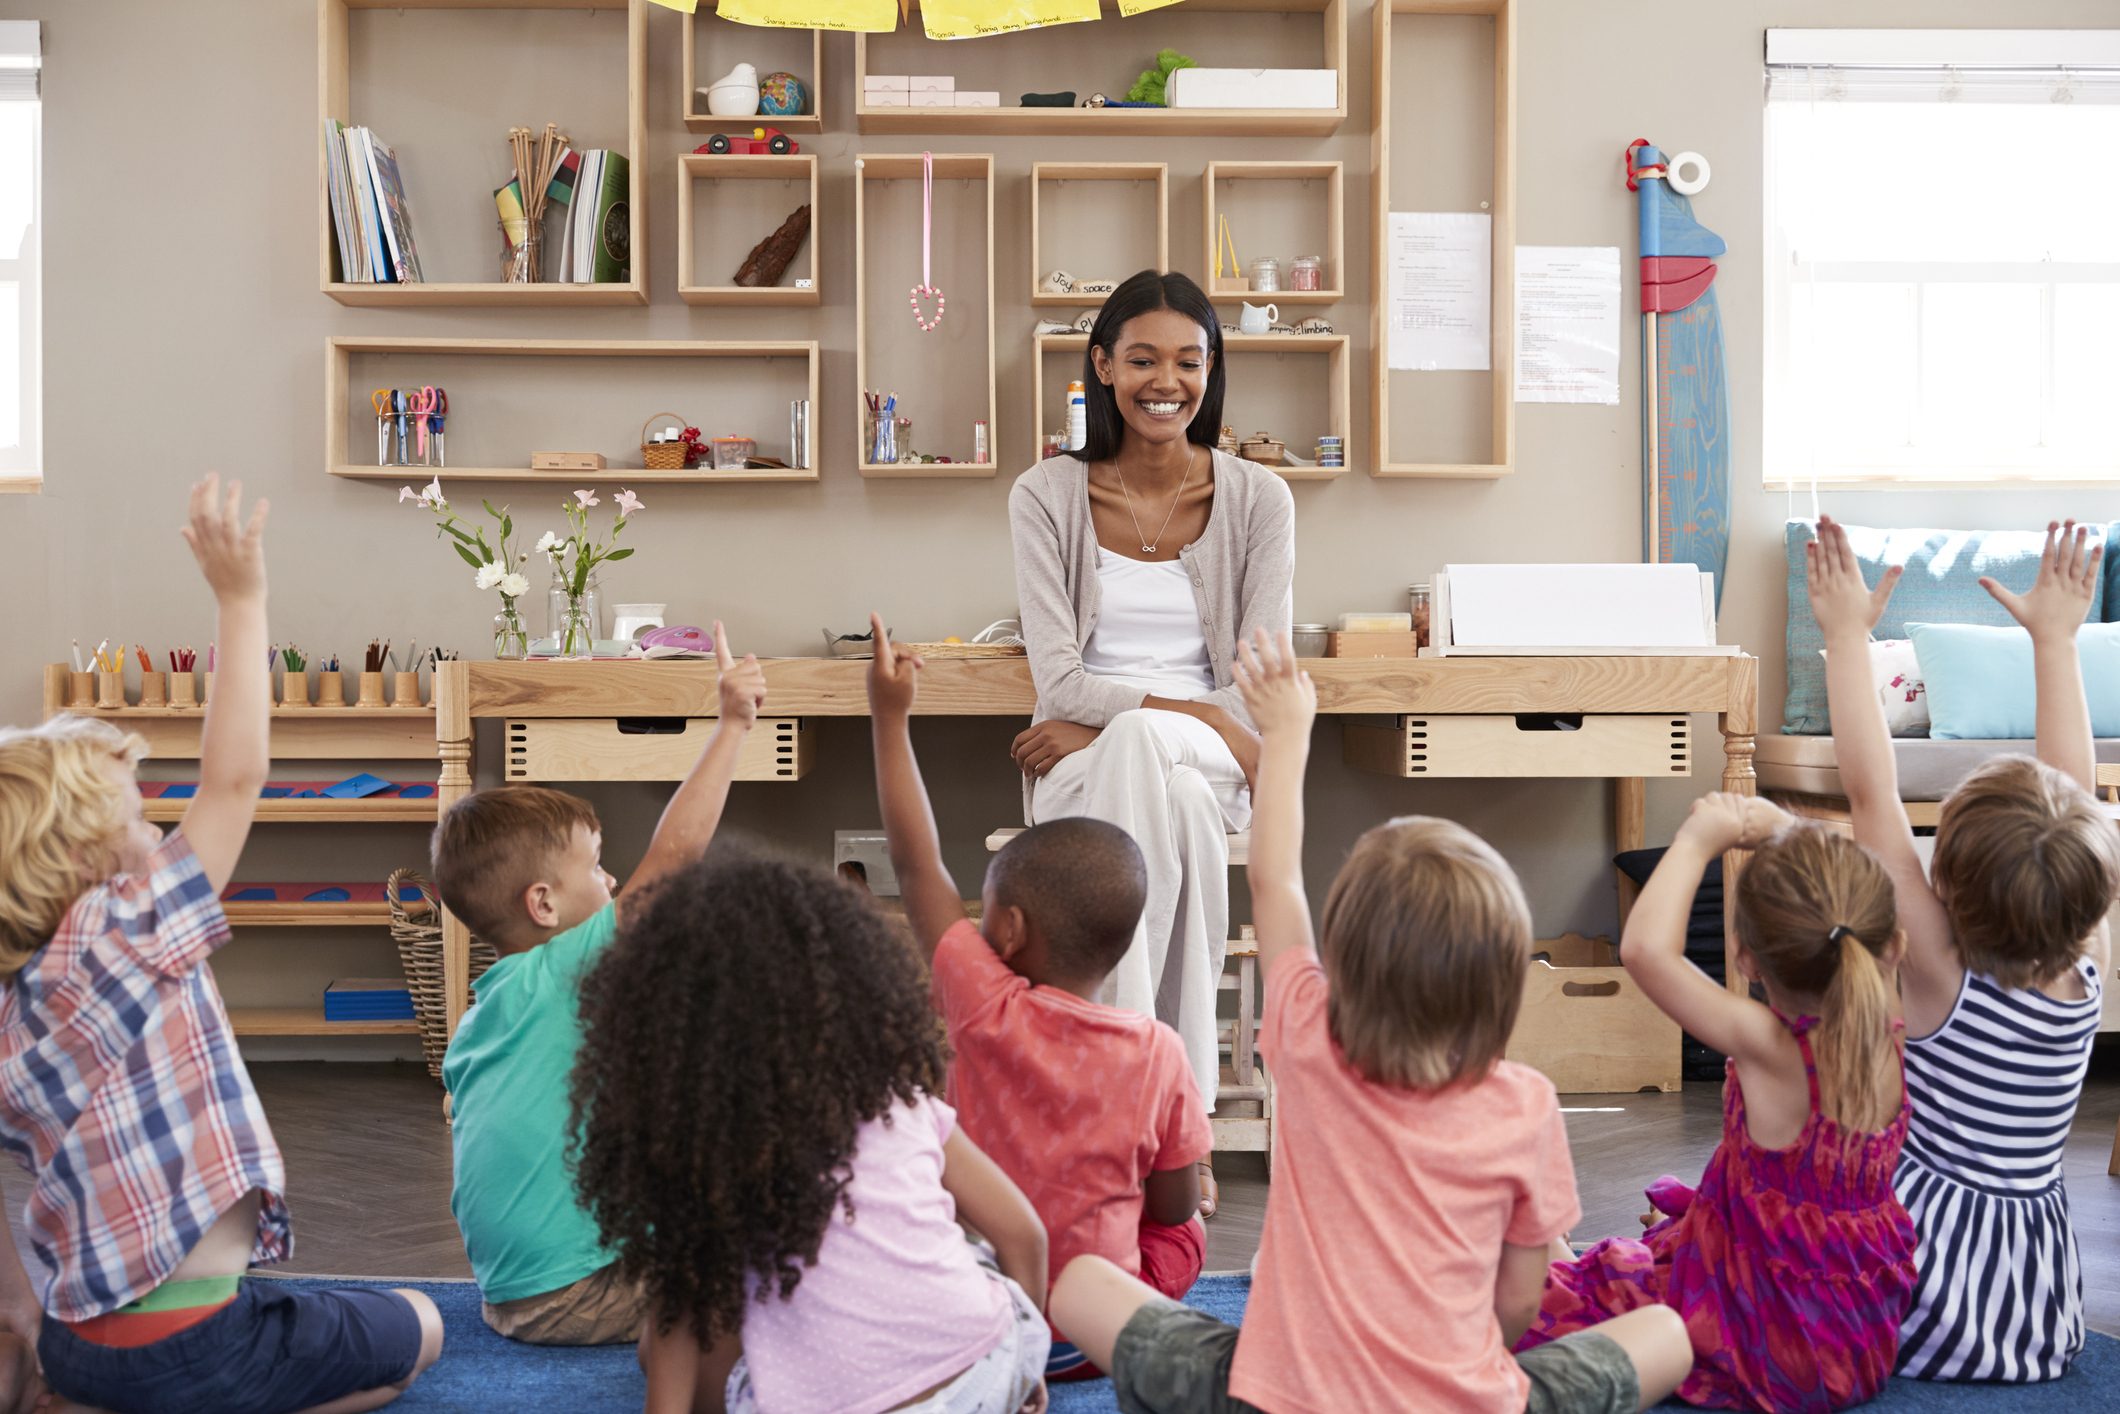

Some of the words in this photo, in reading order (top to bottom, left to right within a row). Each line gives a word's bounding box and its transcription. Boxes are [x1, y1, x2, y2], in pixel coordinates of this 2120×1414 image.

[926, 28, 956, 39] Thomas
[1053, 272, 1072, 293] Joy
[1084, 285, 1112, 293] space
[1080, 317, 1094, 332] Pl
